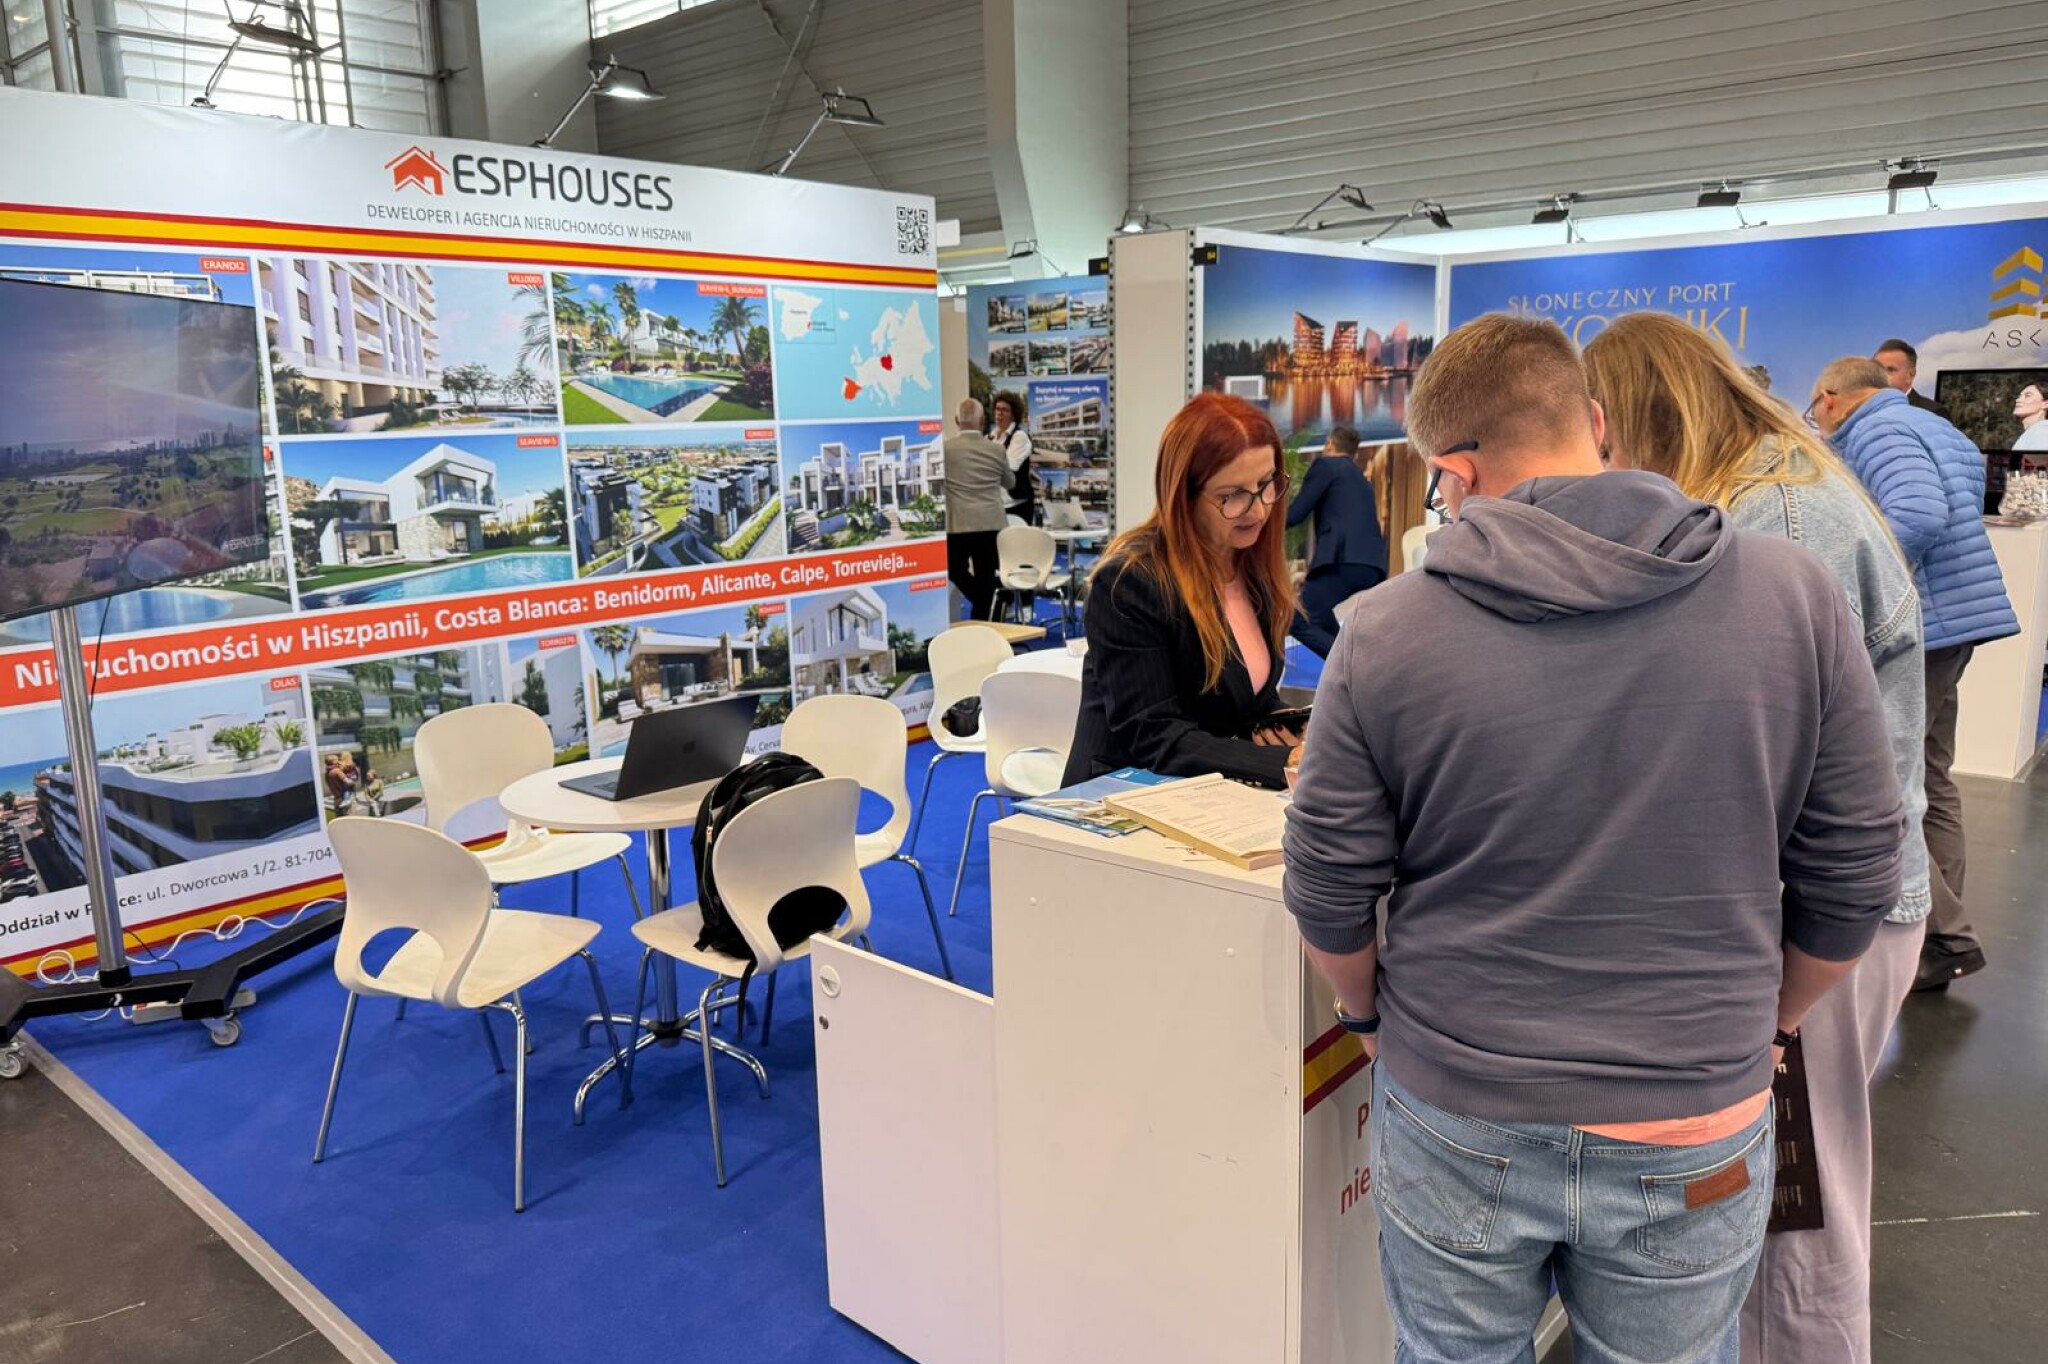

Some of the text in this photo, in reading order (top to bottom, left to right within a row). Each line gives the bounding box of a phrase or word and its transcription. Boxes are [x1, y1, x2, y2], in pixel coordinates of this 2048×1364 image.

[452, 154, 673, 211] ESPHOUSES
[366, 204, 452, 224] DEWELOPER
[455, 211, 460, 224] I
[524, 216, 624, 237] NIERUCHOMOŚCI
[626, 225, 640, 238] W
[641, 227, 693, 242] HISZPANII
[1508, 282, 1737, 311] SŁONECZNY PORT
[14, 634, 260, 688] Niuchomości
[267, 636, 293, 655] w
[301, 612, 429, 648] Hiszpanii,
[435, 605, 501, 632] Costa
[508, 598, 589, 622] Blanca:
[593, 584, 696, 610] Benidorm,
[701, 572, 777, 595] Alicante,
[780, 564, 830, 586] Calpe,
[65, 908, 80, 920] w
[146, 886, 166, 901] ul.
[170, 868, 249, 895] Dworcowa
